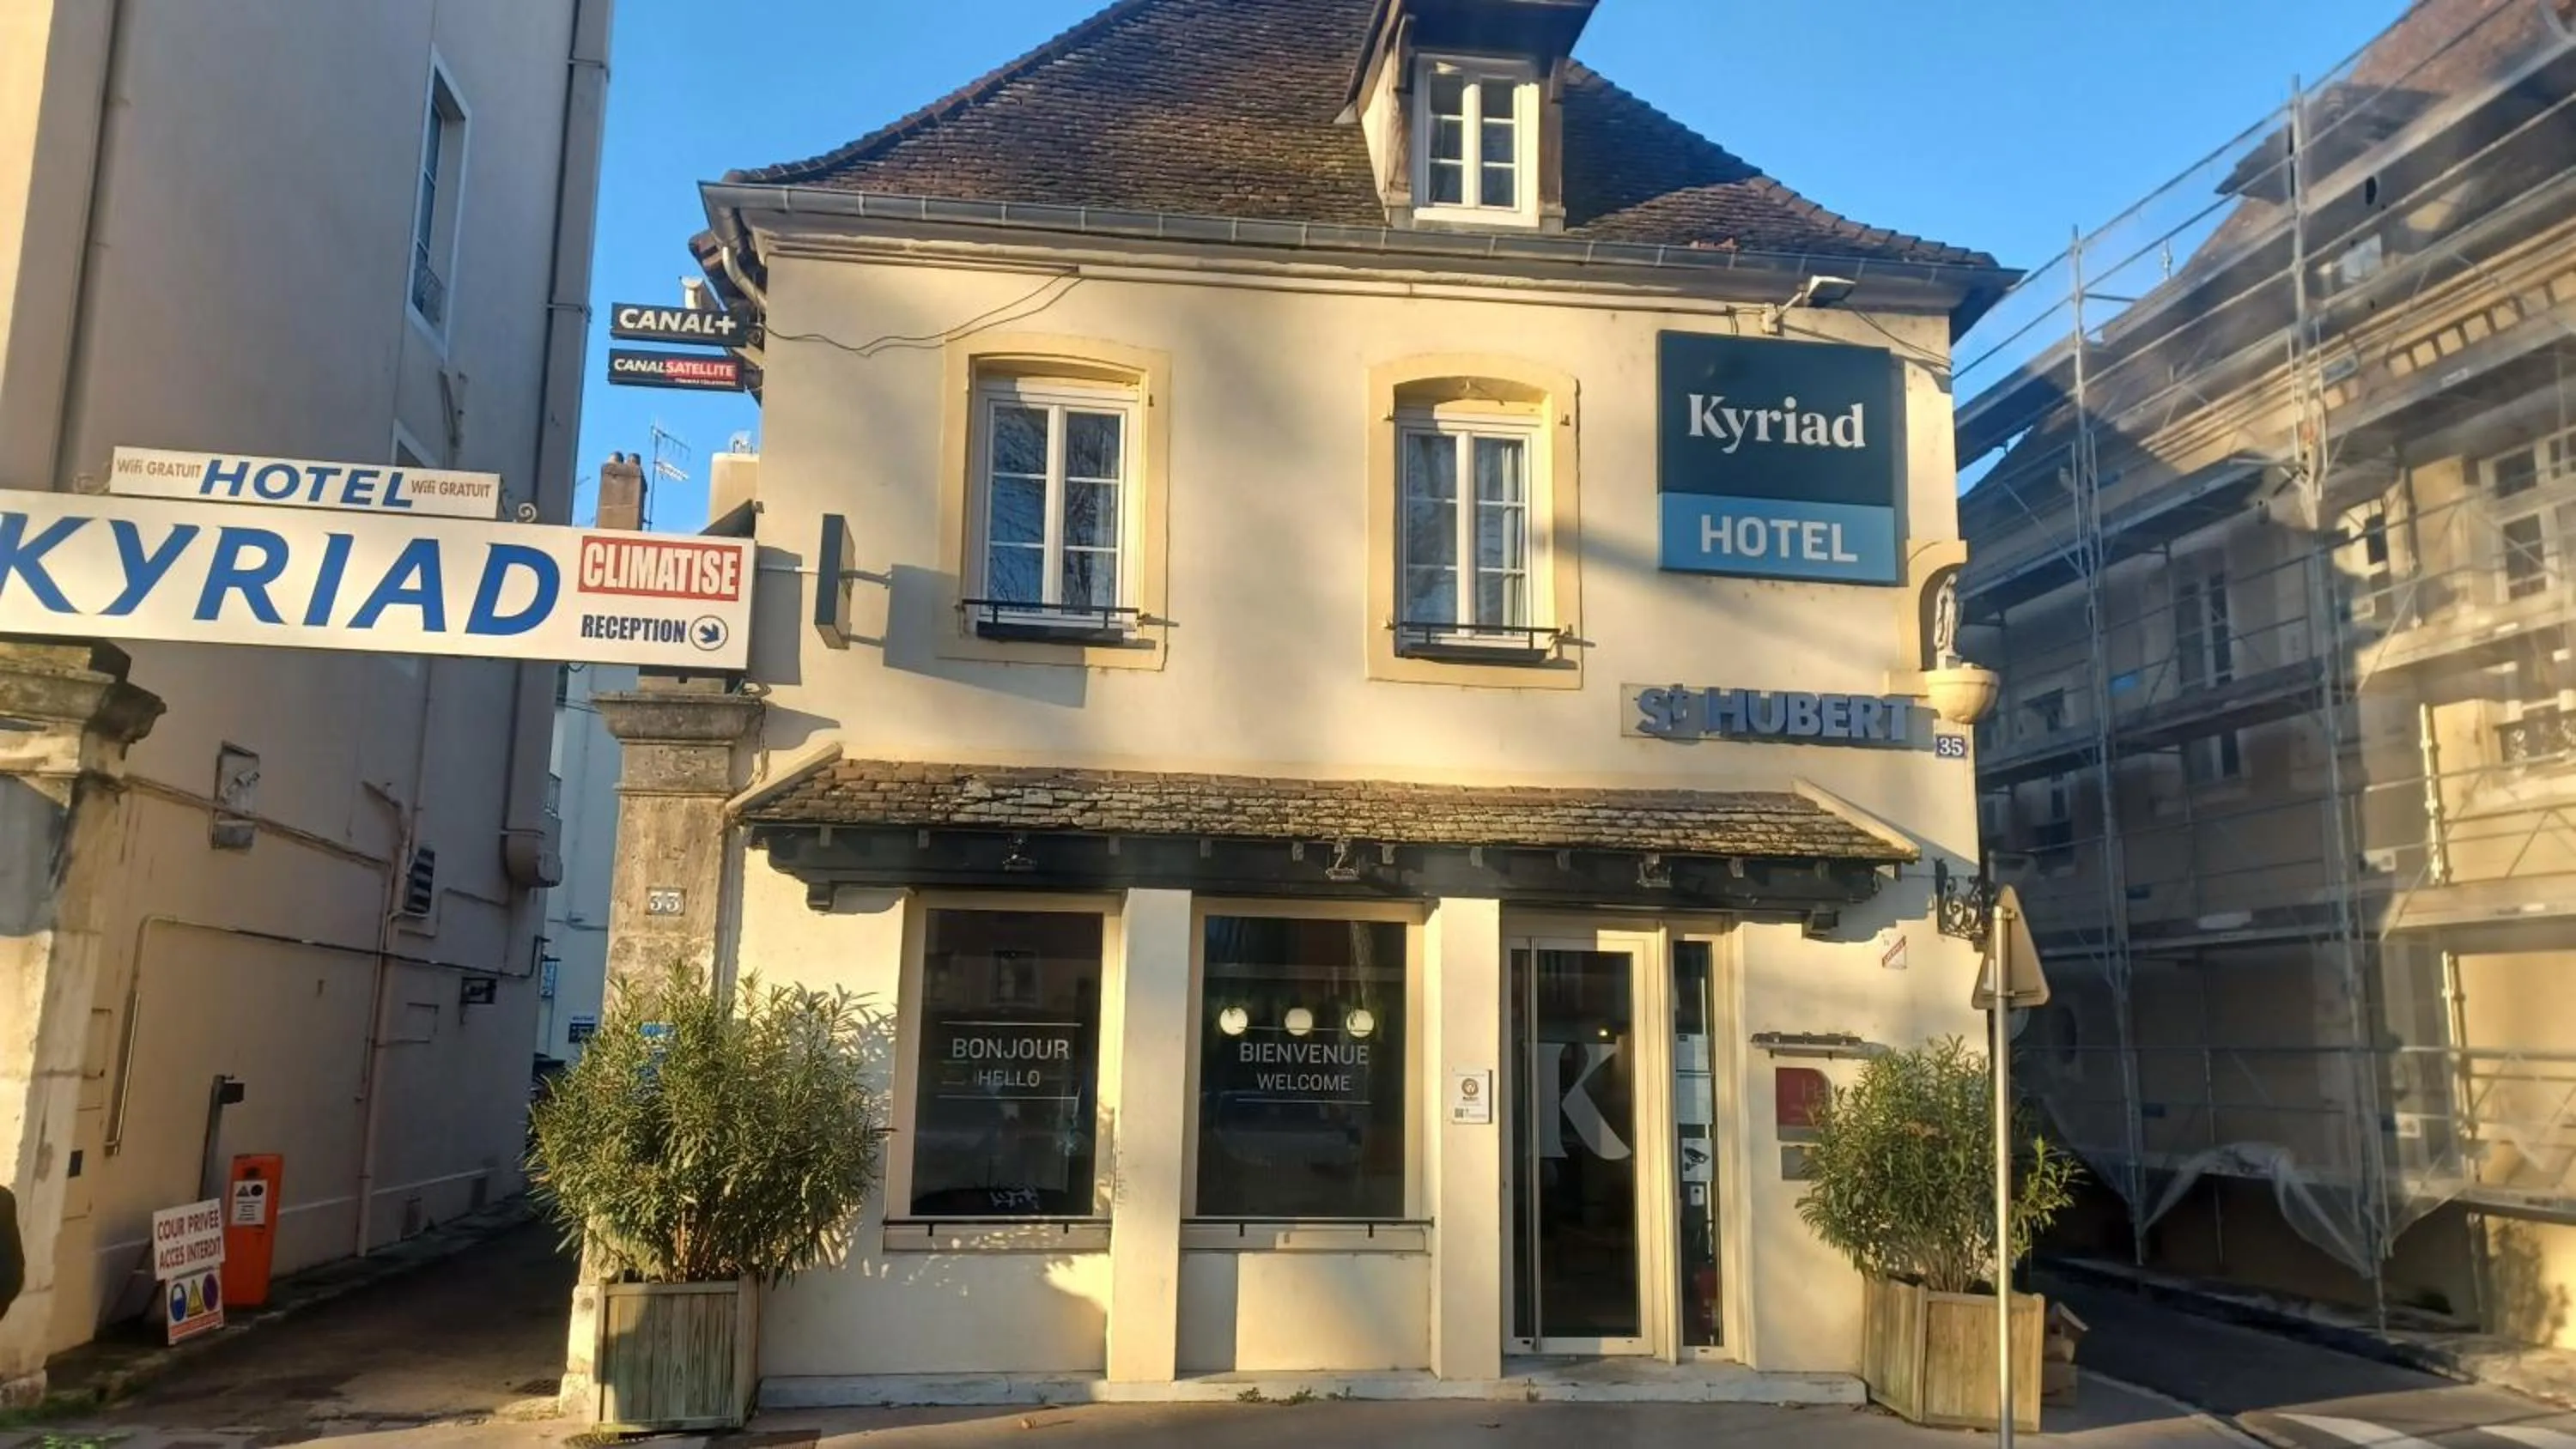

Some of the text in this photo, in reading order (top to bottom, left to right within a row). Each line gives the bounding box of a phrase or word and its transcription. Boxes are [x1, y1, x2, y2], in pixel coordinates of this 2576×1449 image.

[619, 308, 737, 336] CANAL+
[1687, 393, 1867, 454] Kyriad
[117, 459, 202, 478] Wifi GRATUIT
[198, 459, 413, 508] HOTEL
[411, 479, 492, 498] Wifi GRATUIT
[1700, 513, 1858, 563] HOTEL
[0, 512, 561, 635] KYRIAD
[583, 542, 738, 595] CLIMATISE
[580, 614, 686, 643] RECEPTION
[1939, 737, 1964, 756] 35
[951, 1037, 1070, 1060] BONJOUR
[1239, 1041, 1370, 1066] BIENVENUE
[977, 1070, 1040, 1088] HELLO
[1257, 1073, 1351, 1092] WELCOME
[158, 1216, 185, 1241] COUR
[187, 1236, 221, 1263] INTERDIT
